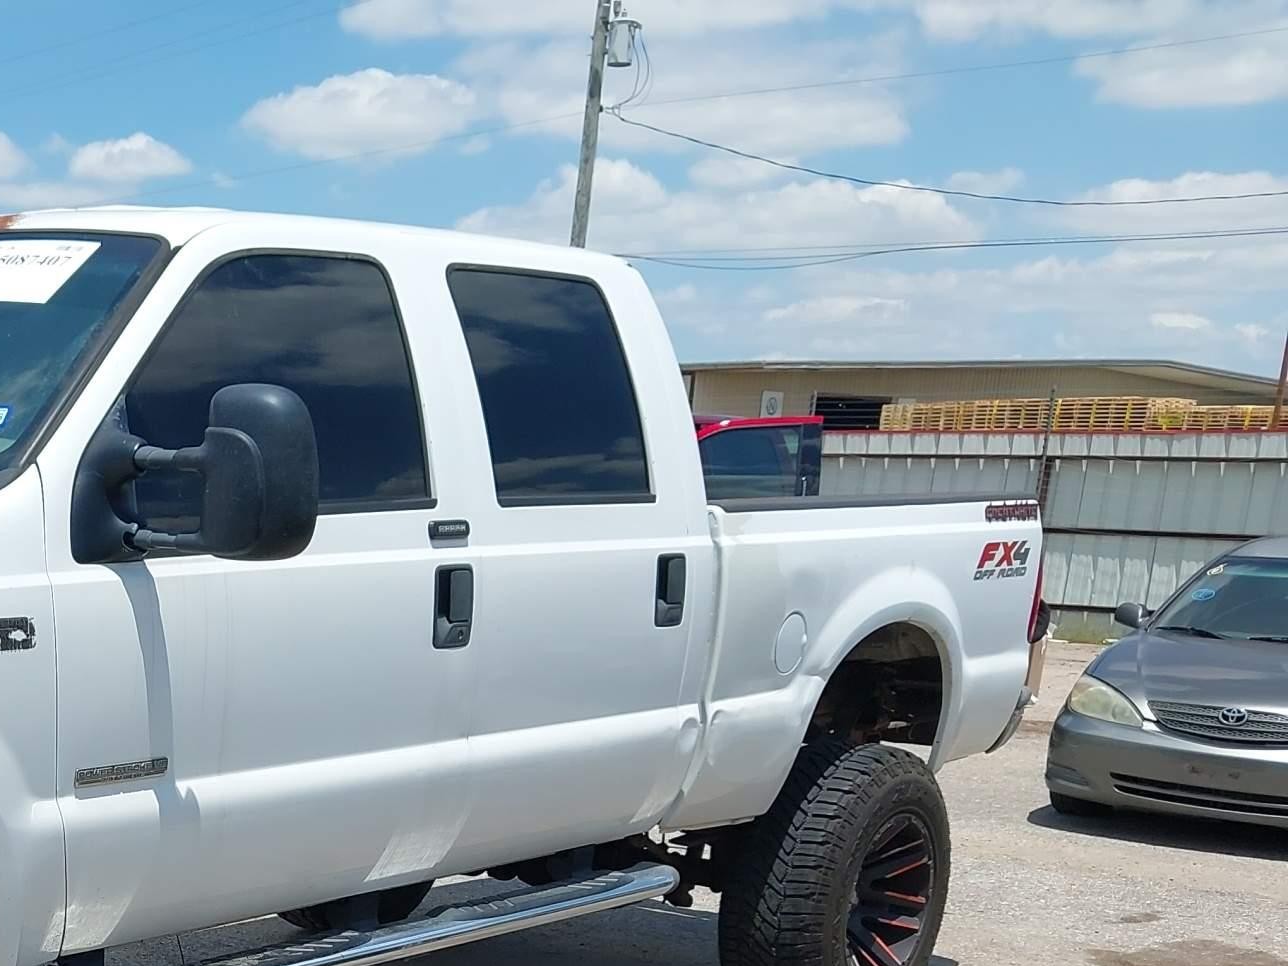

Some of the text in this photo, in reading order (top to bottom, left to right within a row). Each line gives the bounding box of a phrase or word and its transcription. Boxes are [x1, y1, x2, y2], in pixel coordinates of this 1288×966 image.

[977, 540, 1031, 569] FX4
[974, 567, 1027, 580] OFF ROAD
